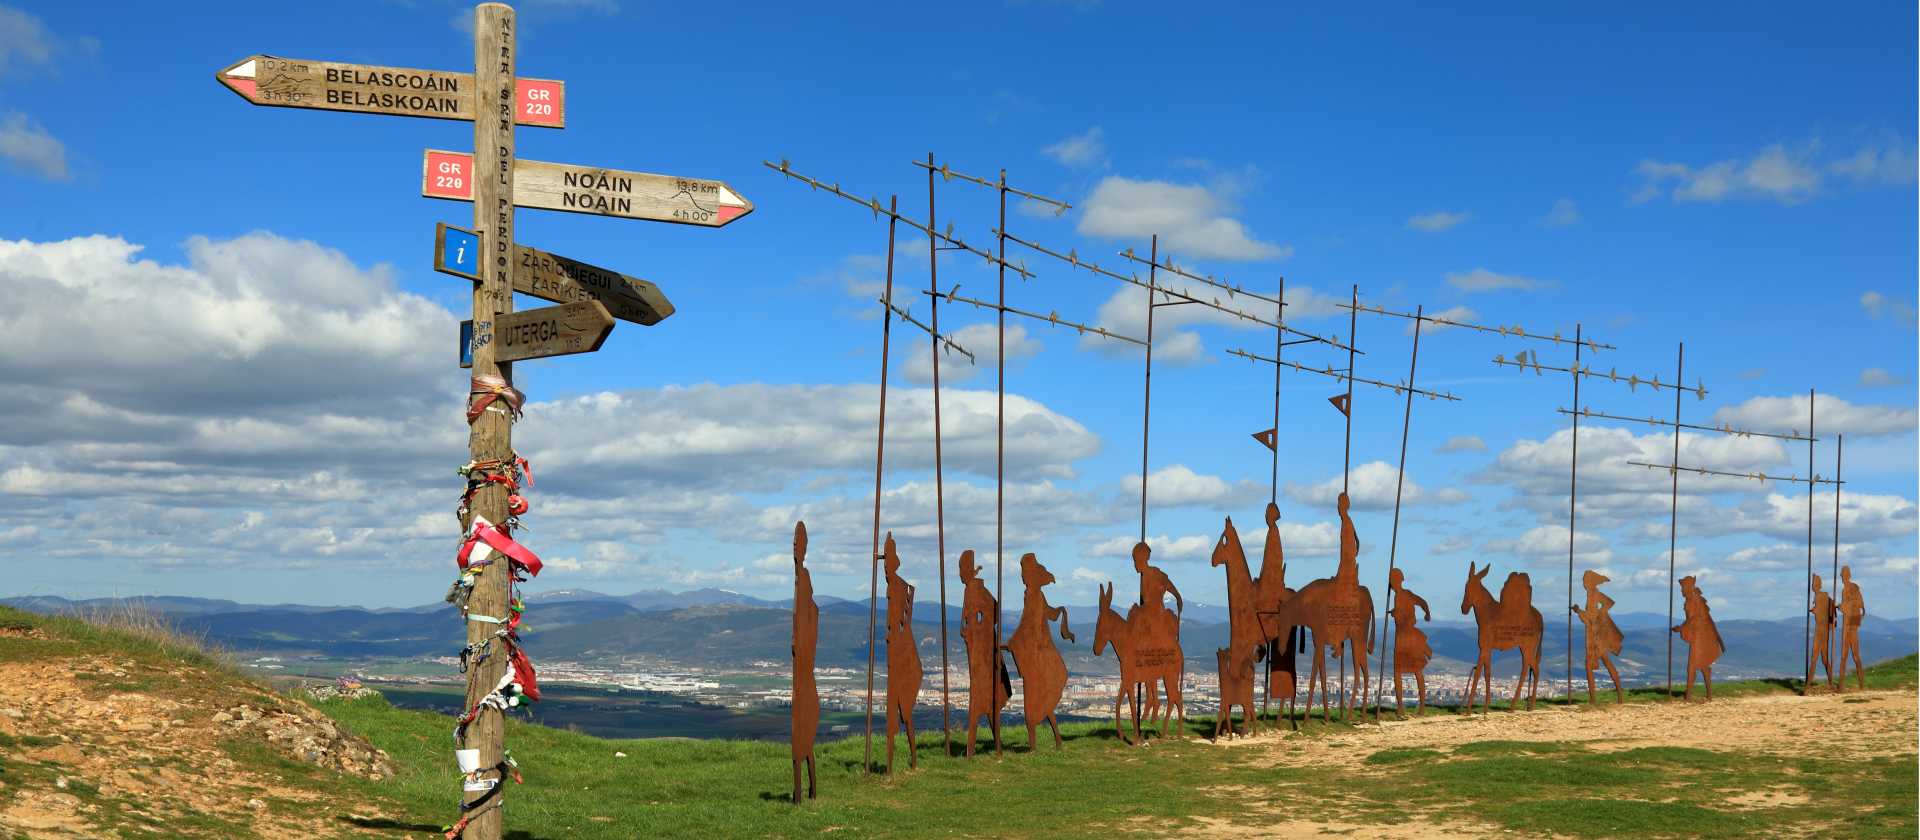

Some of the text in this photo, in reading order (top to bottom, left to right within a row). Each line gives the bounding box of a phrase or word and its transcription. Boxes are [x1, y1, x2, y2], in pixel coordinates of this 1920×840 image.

[290, 64, 309, 73] km
[326, 68, 458, 92] BELASCOÁIN
[263, 90, 271, 100] 3
[326, 89, 458, 113] BELASKOAIN
[527, 88, 551, 101] GR
[526, 102, 552, 116] 220
[439, 161, 461, 175] GR
[499, 147, 509, 184] DEL
[436, 175, 463, 189] 220
[564, 170, 633, 193] NOÁIN
[700, 183, 718, 194] km
[563, 191, 632, 213] NOAIN
[672, 209, 680, 218] 4
[682, 209, 689, 220] h
[457, 239, 467, 265] i
[496, 199, 508, 283] PERDON
[522, 252, 612, 291] ZARIQUIEGUI
[505, 319, 560, 347] UTERGA
